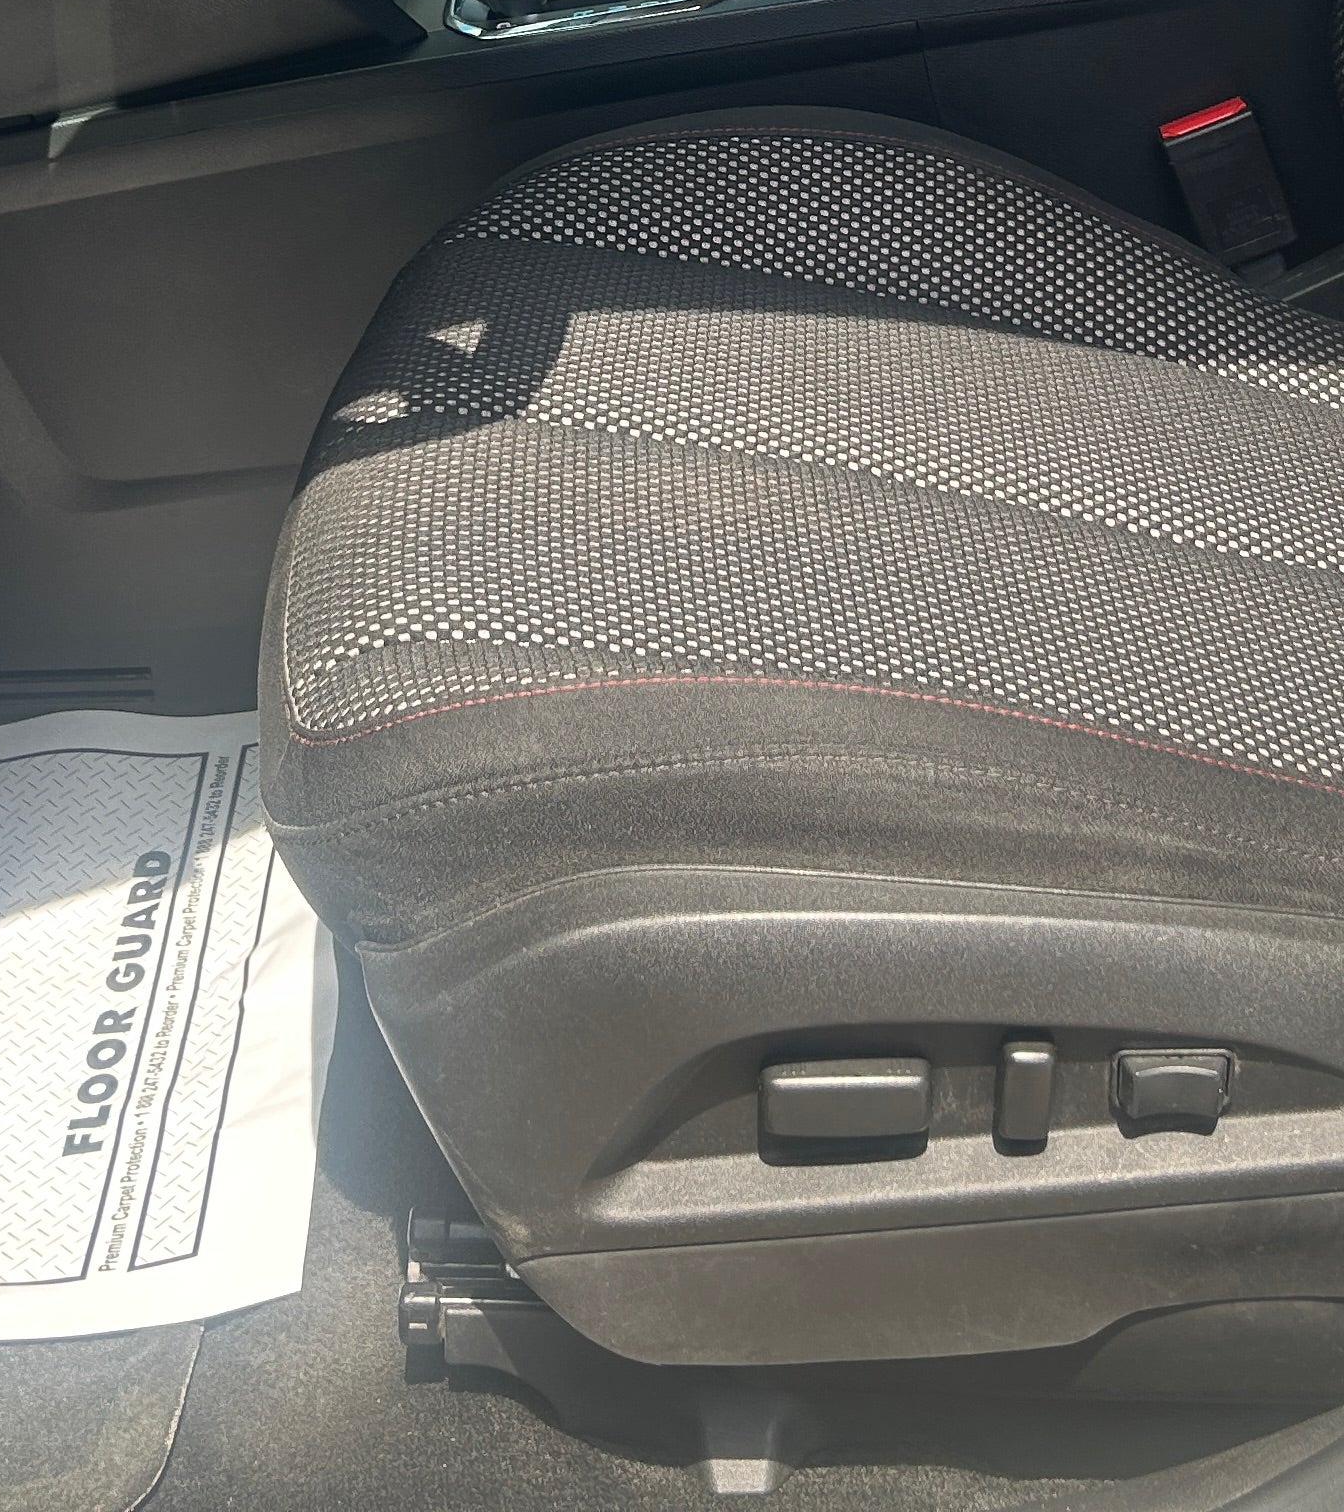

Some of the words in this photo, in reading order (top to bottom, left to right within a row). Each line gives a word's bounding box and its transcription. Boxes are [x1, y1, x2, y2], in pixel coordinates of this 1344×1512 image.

[209, 757, 230, 789] Reorder
[209, 790, 224, 799] to
[184, 868, 205, 914] Protection
[177, 916, 197, 947] Carpet
[166, 950, 190, 992] Premium
[61, 1006, 137, 1157] FLOOR
[105, 850, 171, 992] GUARD
[154, 1001, 179, 1038] Reorder
[152, 1039, 169, 1049] to
[141, 1050, 167, 1093] 247-5432
[120, 1128, 148, 1182] Protection
[111, 1185, 135, 1221] Carpet
[98, 1224, 127, 1272] Premium
